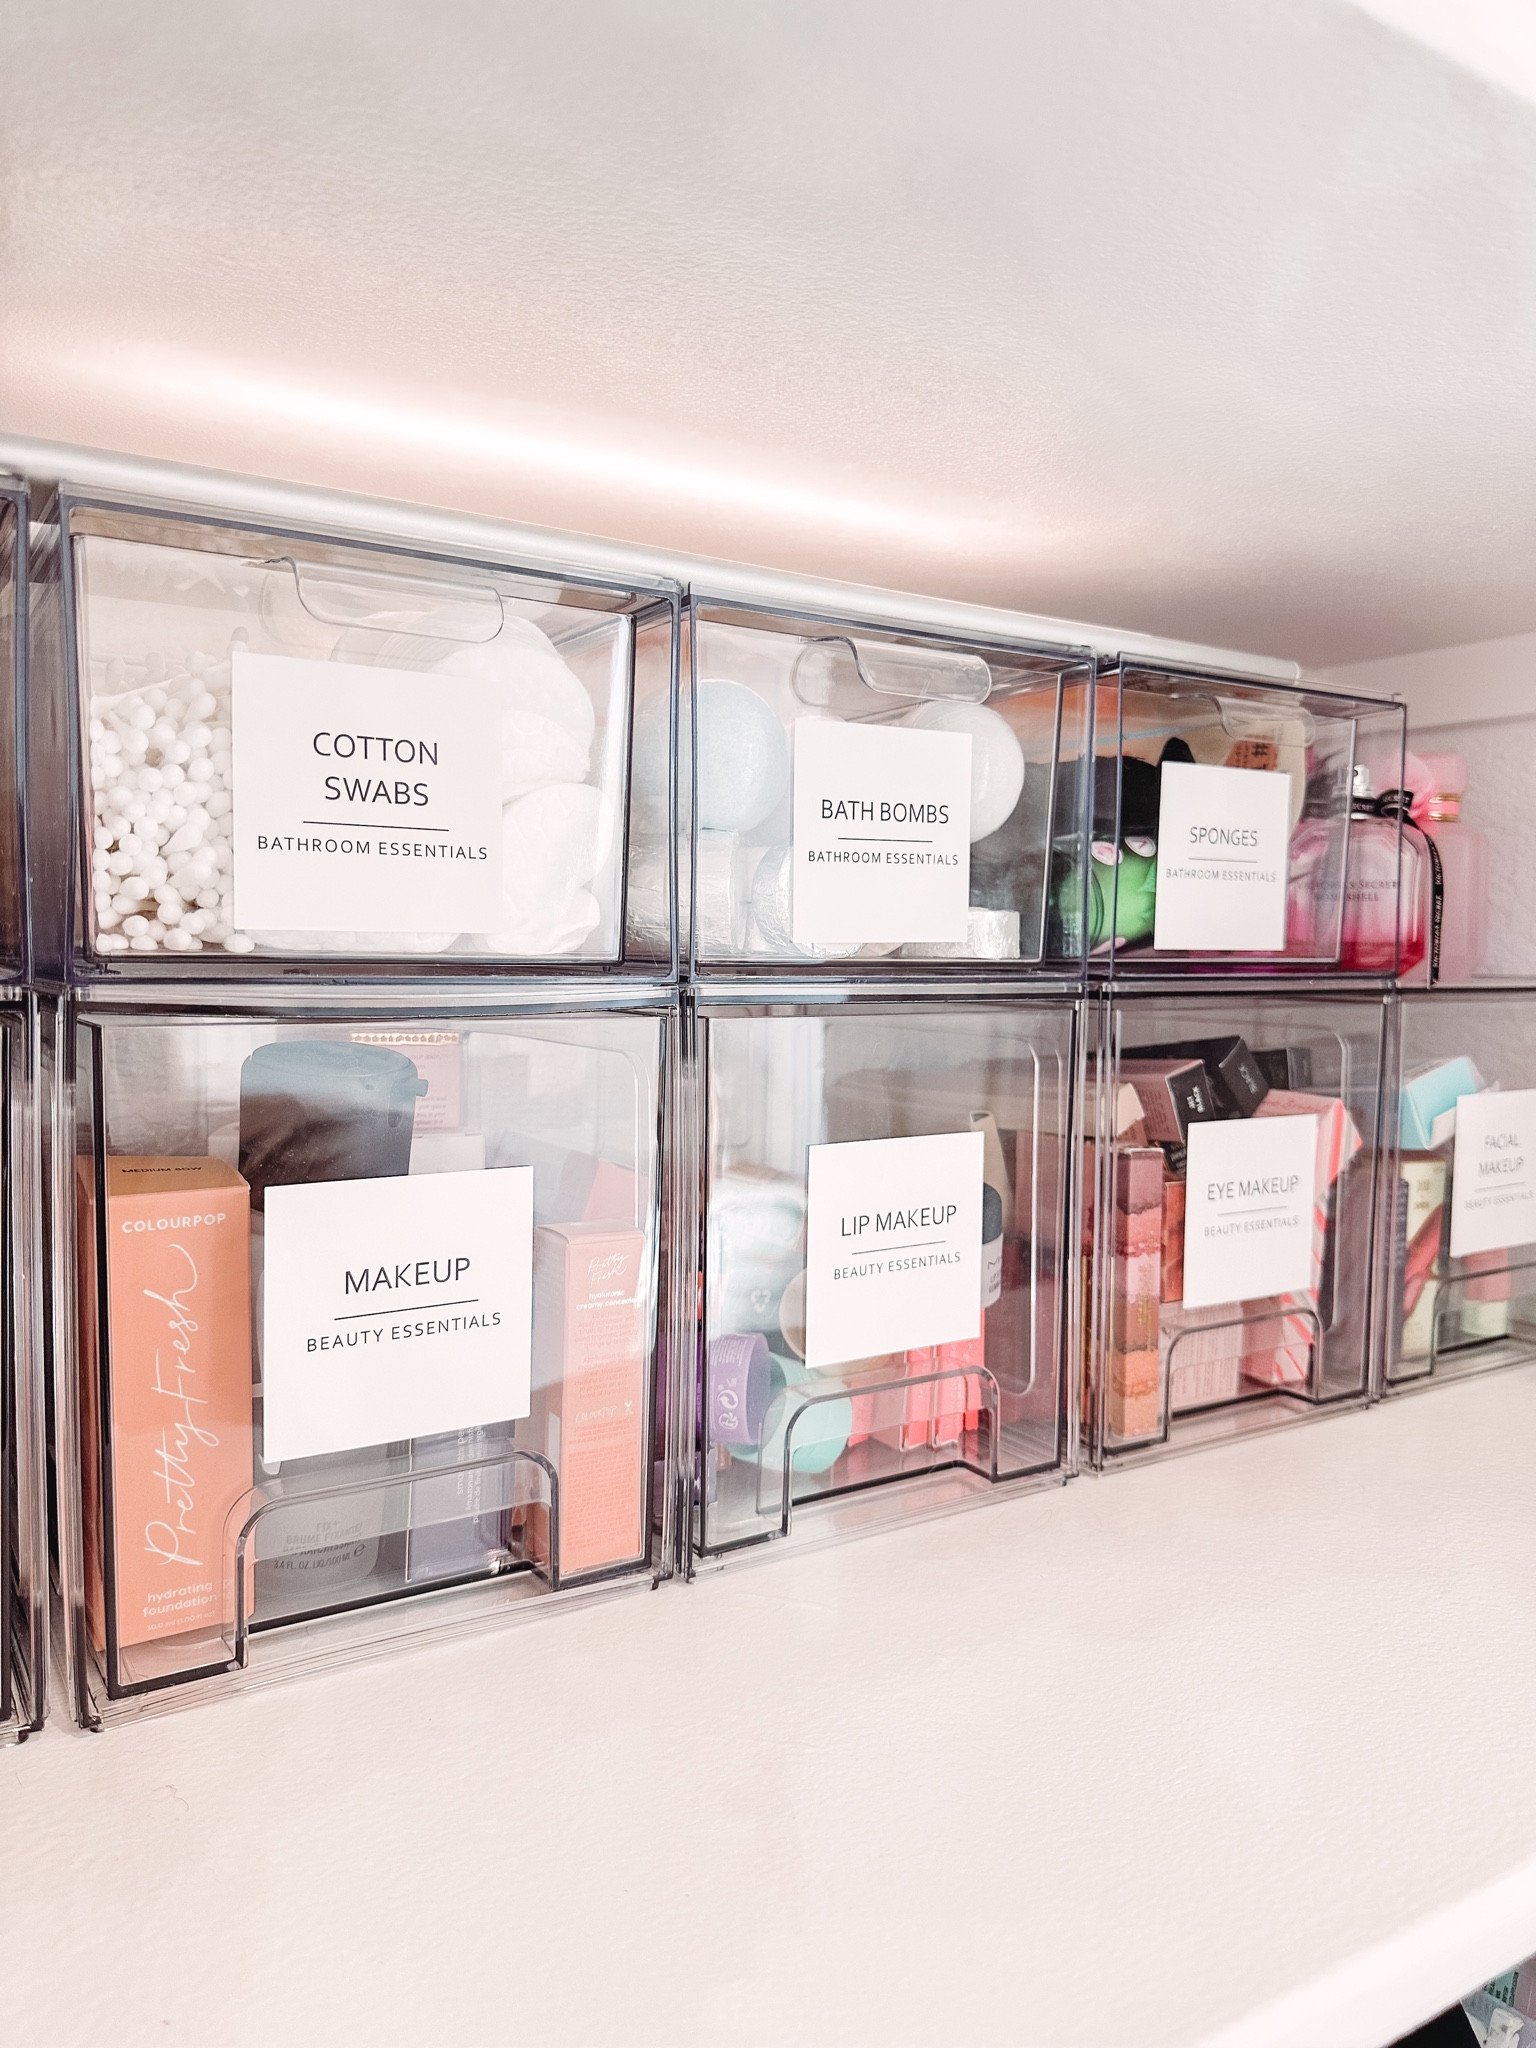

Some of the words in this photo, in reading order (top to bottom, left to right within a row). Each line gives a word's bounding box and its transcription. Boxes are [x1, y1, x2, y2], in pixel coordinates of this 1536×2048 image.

[313, 732, 439, 765] COTTON
[324, 776, 429, 806] SWABS
[822, 799, 874, 821] BATH
[880, 802, 949, 824] BOMBS
[257, 835, 371, 854] BATHROOM
[378, 841, 488, 860] ESSENTIALS
[1189, 826, 1258, 847] SPONGES
[808, 850, 881, 863] BATHROOM
[886, 852, 958, 865] ESSENTIALS
[1165, 868, 1219, 880] BATHROOM
[1222, 871, 1277, 882] ESSENTIALS
[1484, 1133, 1519, 1149] FACIAL
[1479, 1156, 1524, 1176] MAKEUP
[1207, 1181, 1234, 1200] EYE
[1238, 1174, 1299, 1197] MAKEUP
[122, 1213, 226, 1233] COLOURPOP
[841, 1215, 870, 1236] LIP
[875, 1204, 957, 1232] MAKEUP
[1204, 1222, 1241, 1237] BEAUTY
[1243, 1215, 1299, 1232] ESSENTIALS
[345, 1257, 471, 1294] MAKEUP
[833, 1262, 884, 1280] BEAUTY
[888, 1251, 961, 1272] ESSENTIALS
[307, 1328, 384, 1352] BEAUTY
[391, 1312, 501, 1340] ESSENTIALS
[147, 1582, 213, 1603] hydrating
[142, 1594, 218, 1617] foundation
